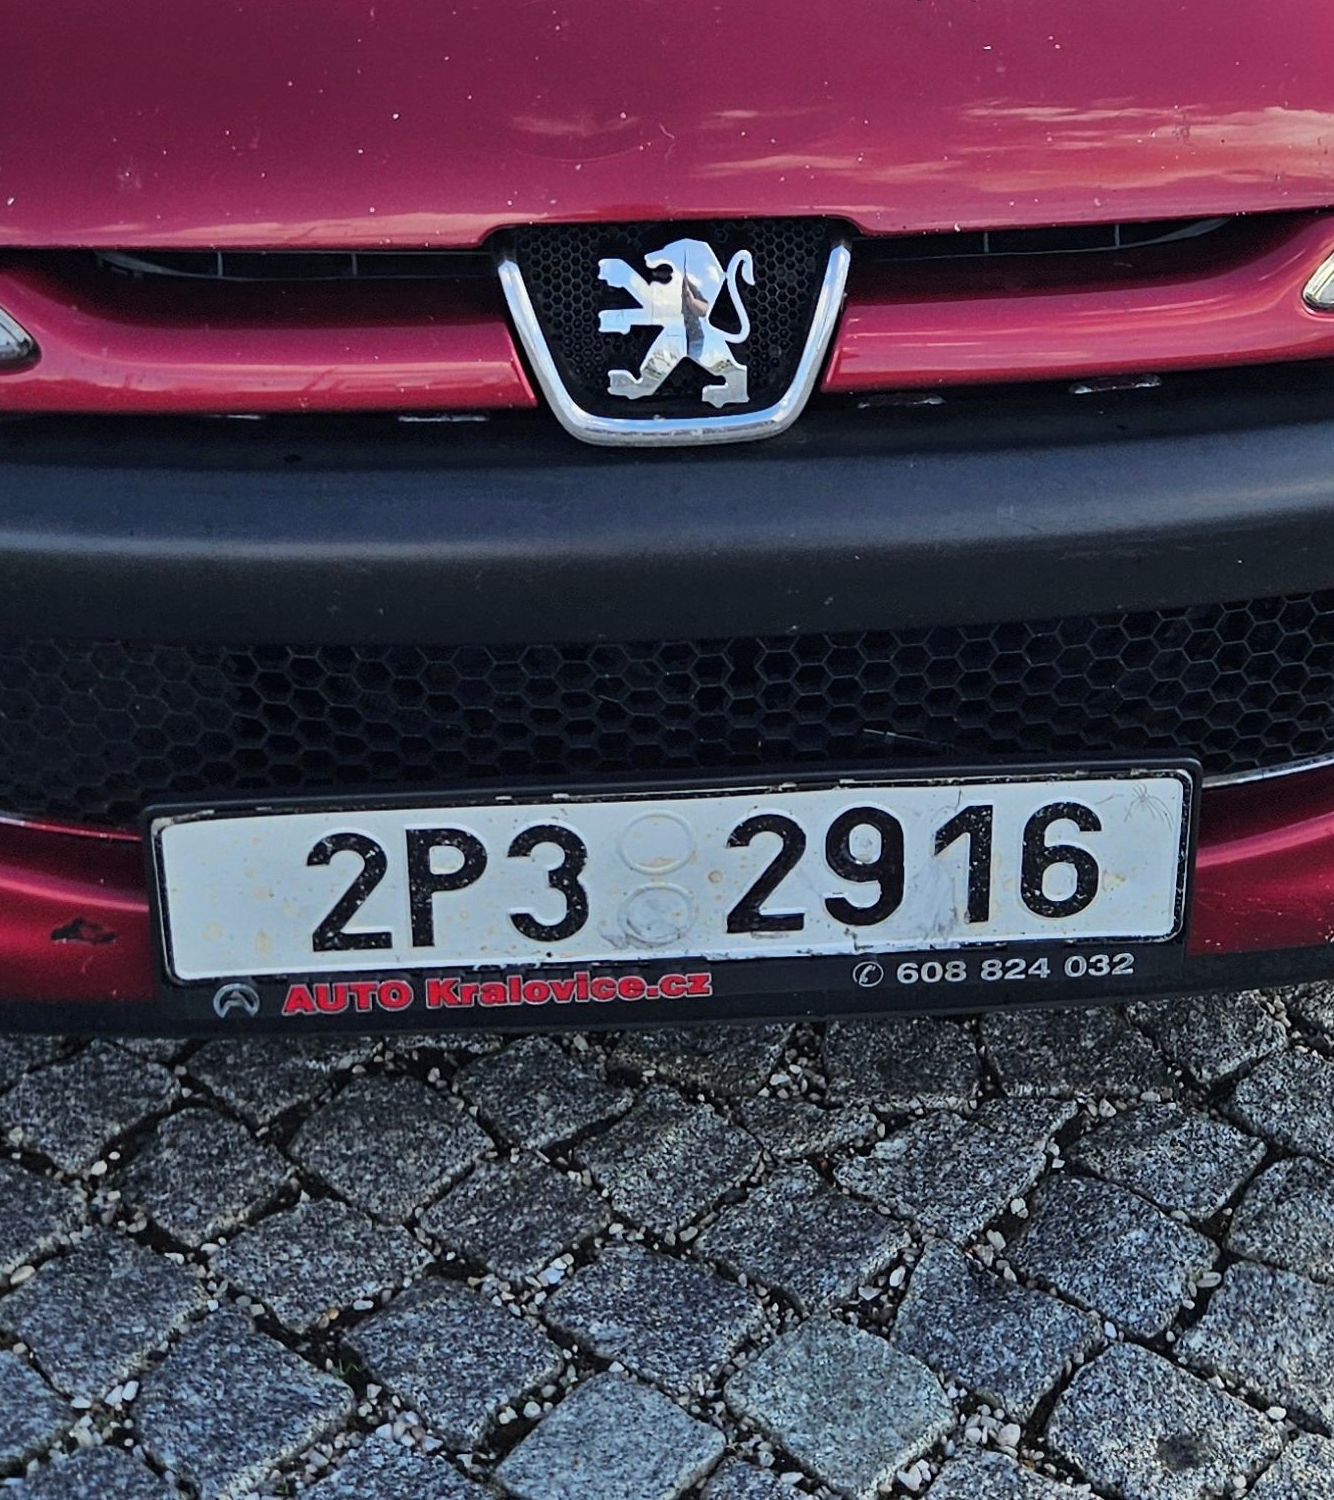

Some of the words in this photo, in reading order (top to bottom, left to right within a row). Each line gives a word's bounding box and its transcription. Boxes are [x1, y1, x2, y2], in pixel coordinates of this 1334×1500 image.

[305, 822, 590, 953] 2P3
[724, 803, 1103, 934] 2916
[896, 960, 968, 985] 608
[980, 957, 1052, 982] 824
[1064, 952, 1136, 978] 032
[281, 979, 413, 1017] AUTO
[425, 971, 713, 1009] Kralovice.cz
